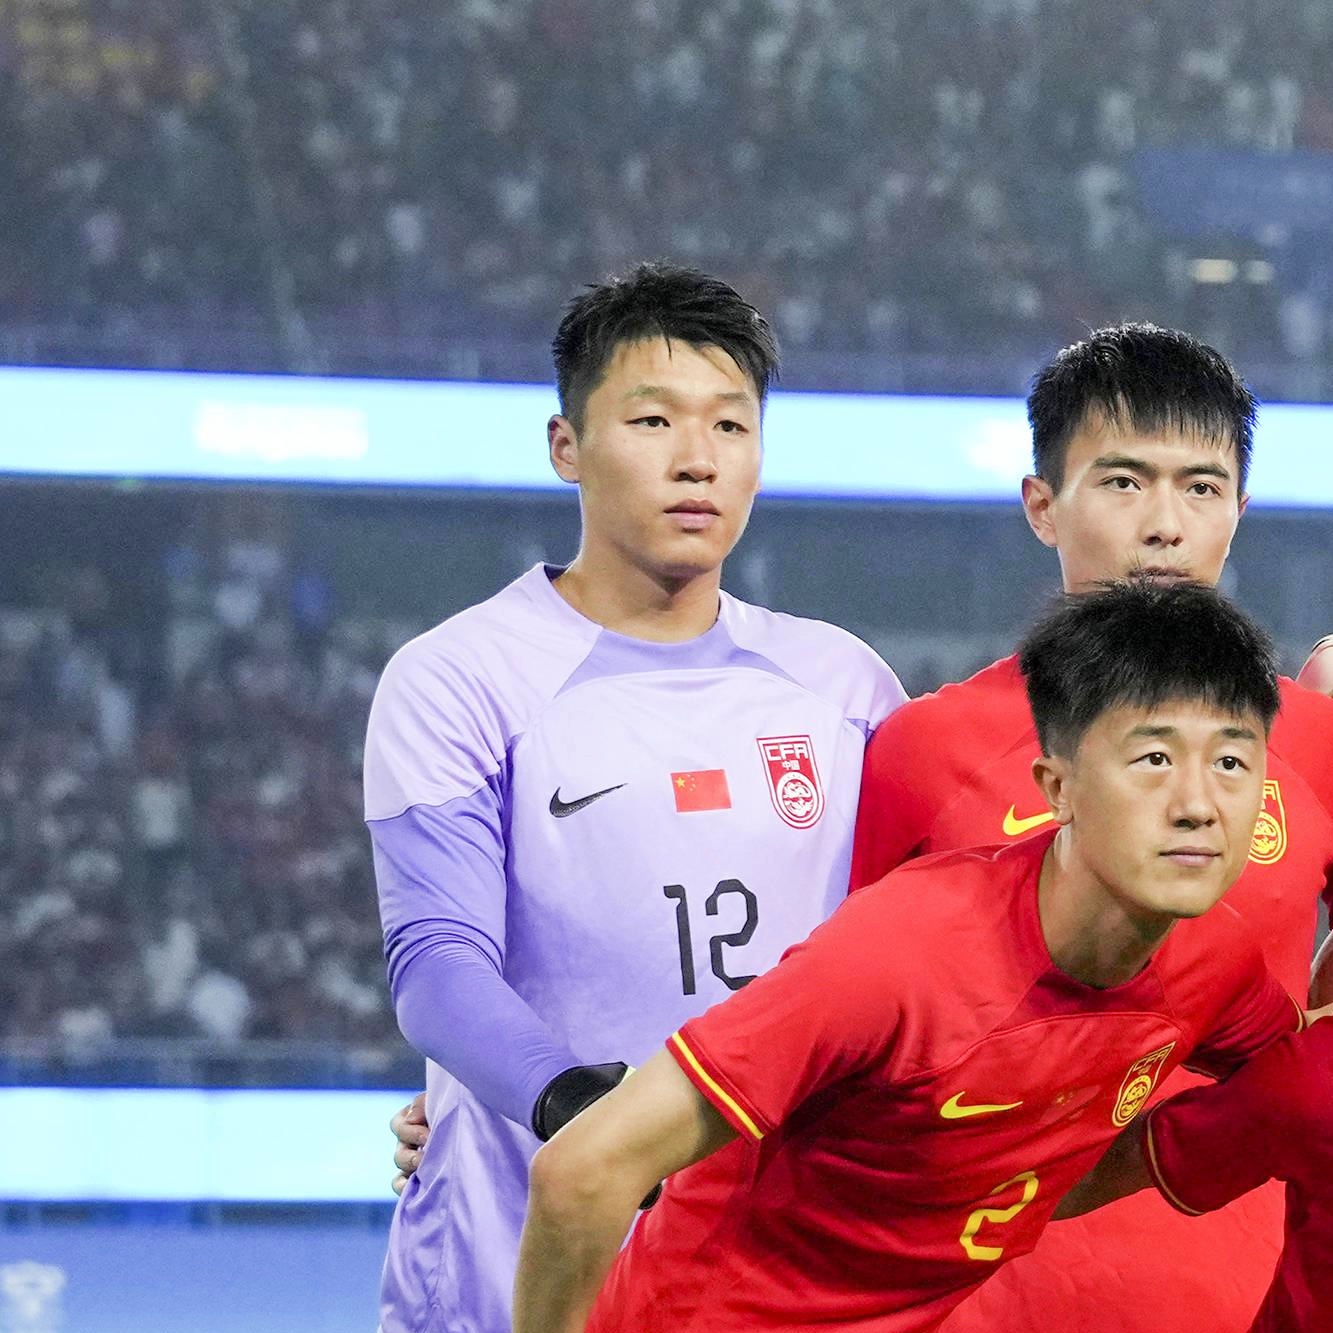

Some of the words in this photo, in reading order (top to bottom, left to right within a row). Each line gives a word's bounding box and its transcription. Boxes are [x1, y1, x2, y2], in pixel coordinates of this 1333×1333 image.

[765, 743, 808, 761] CFA
[663, 878, 758, 996] 12
[959, 1171, 1039, 1261] 2
